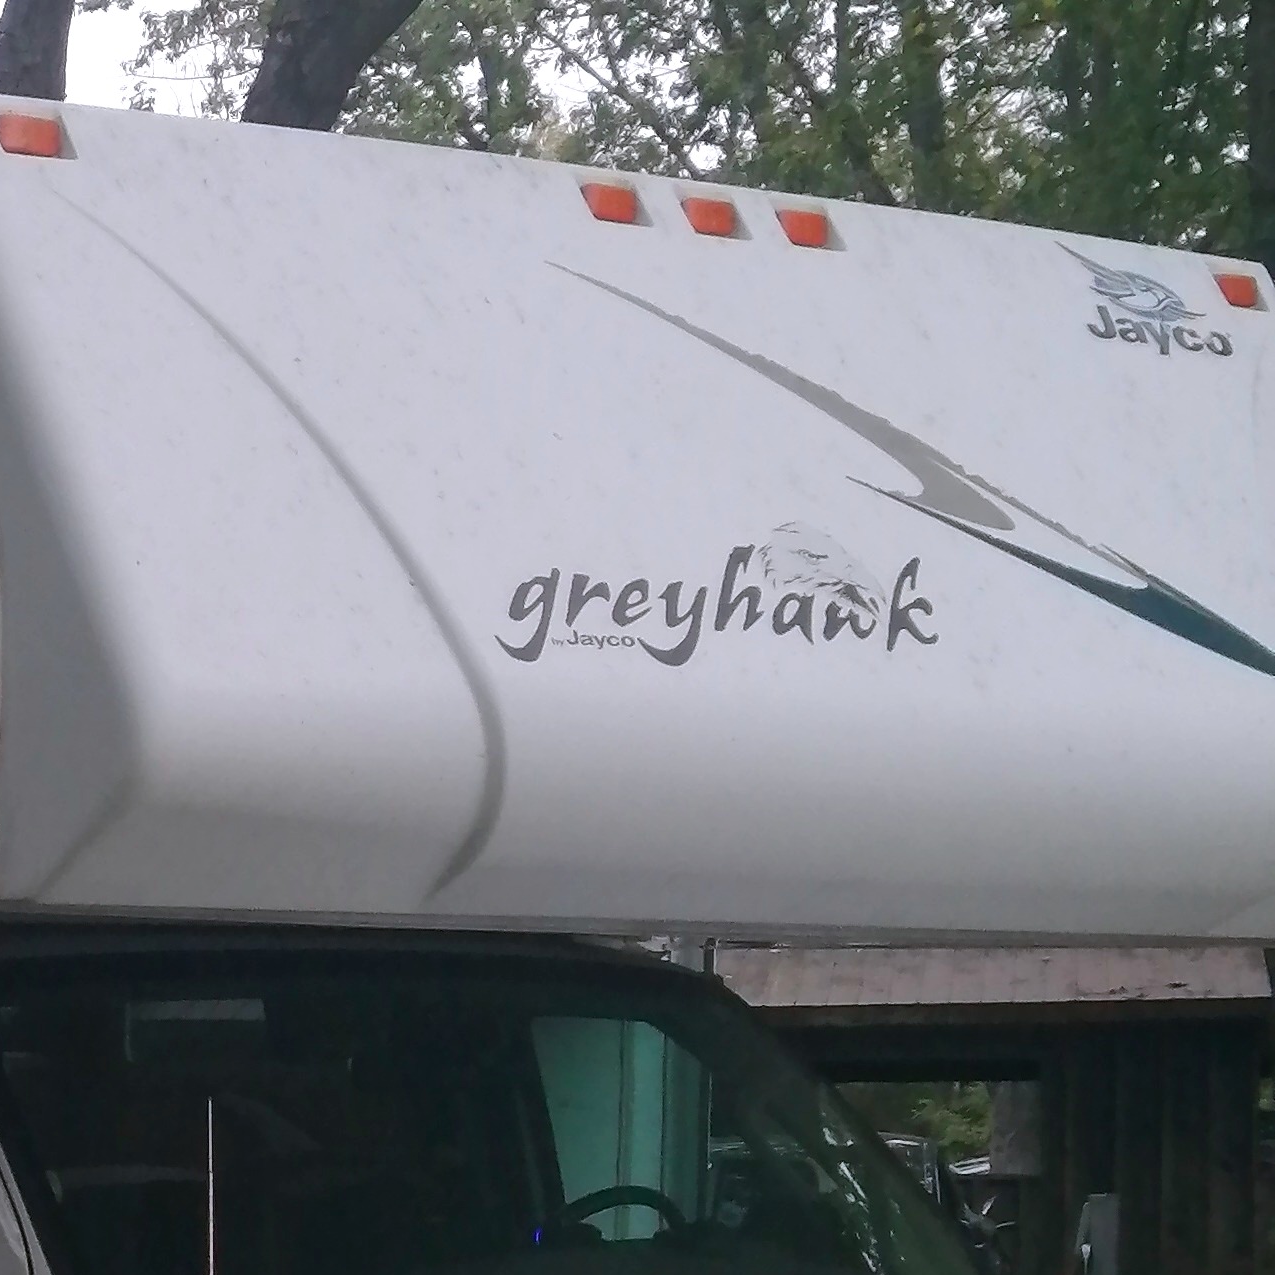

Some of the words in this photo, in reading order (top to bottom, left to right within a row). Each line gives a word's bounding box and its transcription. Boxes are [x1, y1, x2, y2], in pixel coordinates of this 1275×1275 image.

[1087, 303, 1234, 357] Jayco
[494, 543, 939, 666] greyhawk
[566, 629, 636, 650] Jayco
